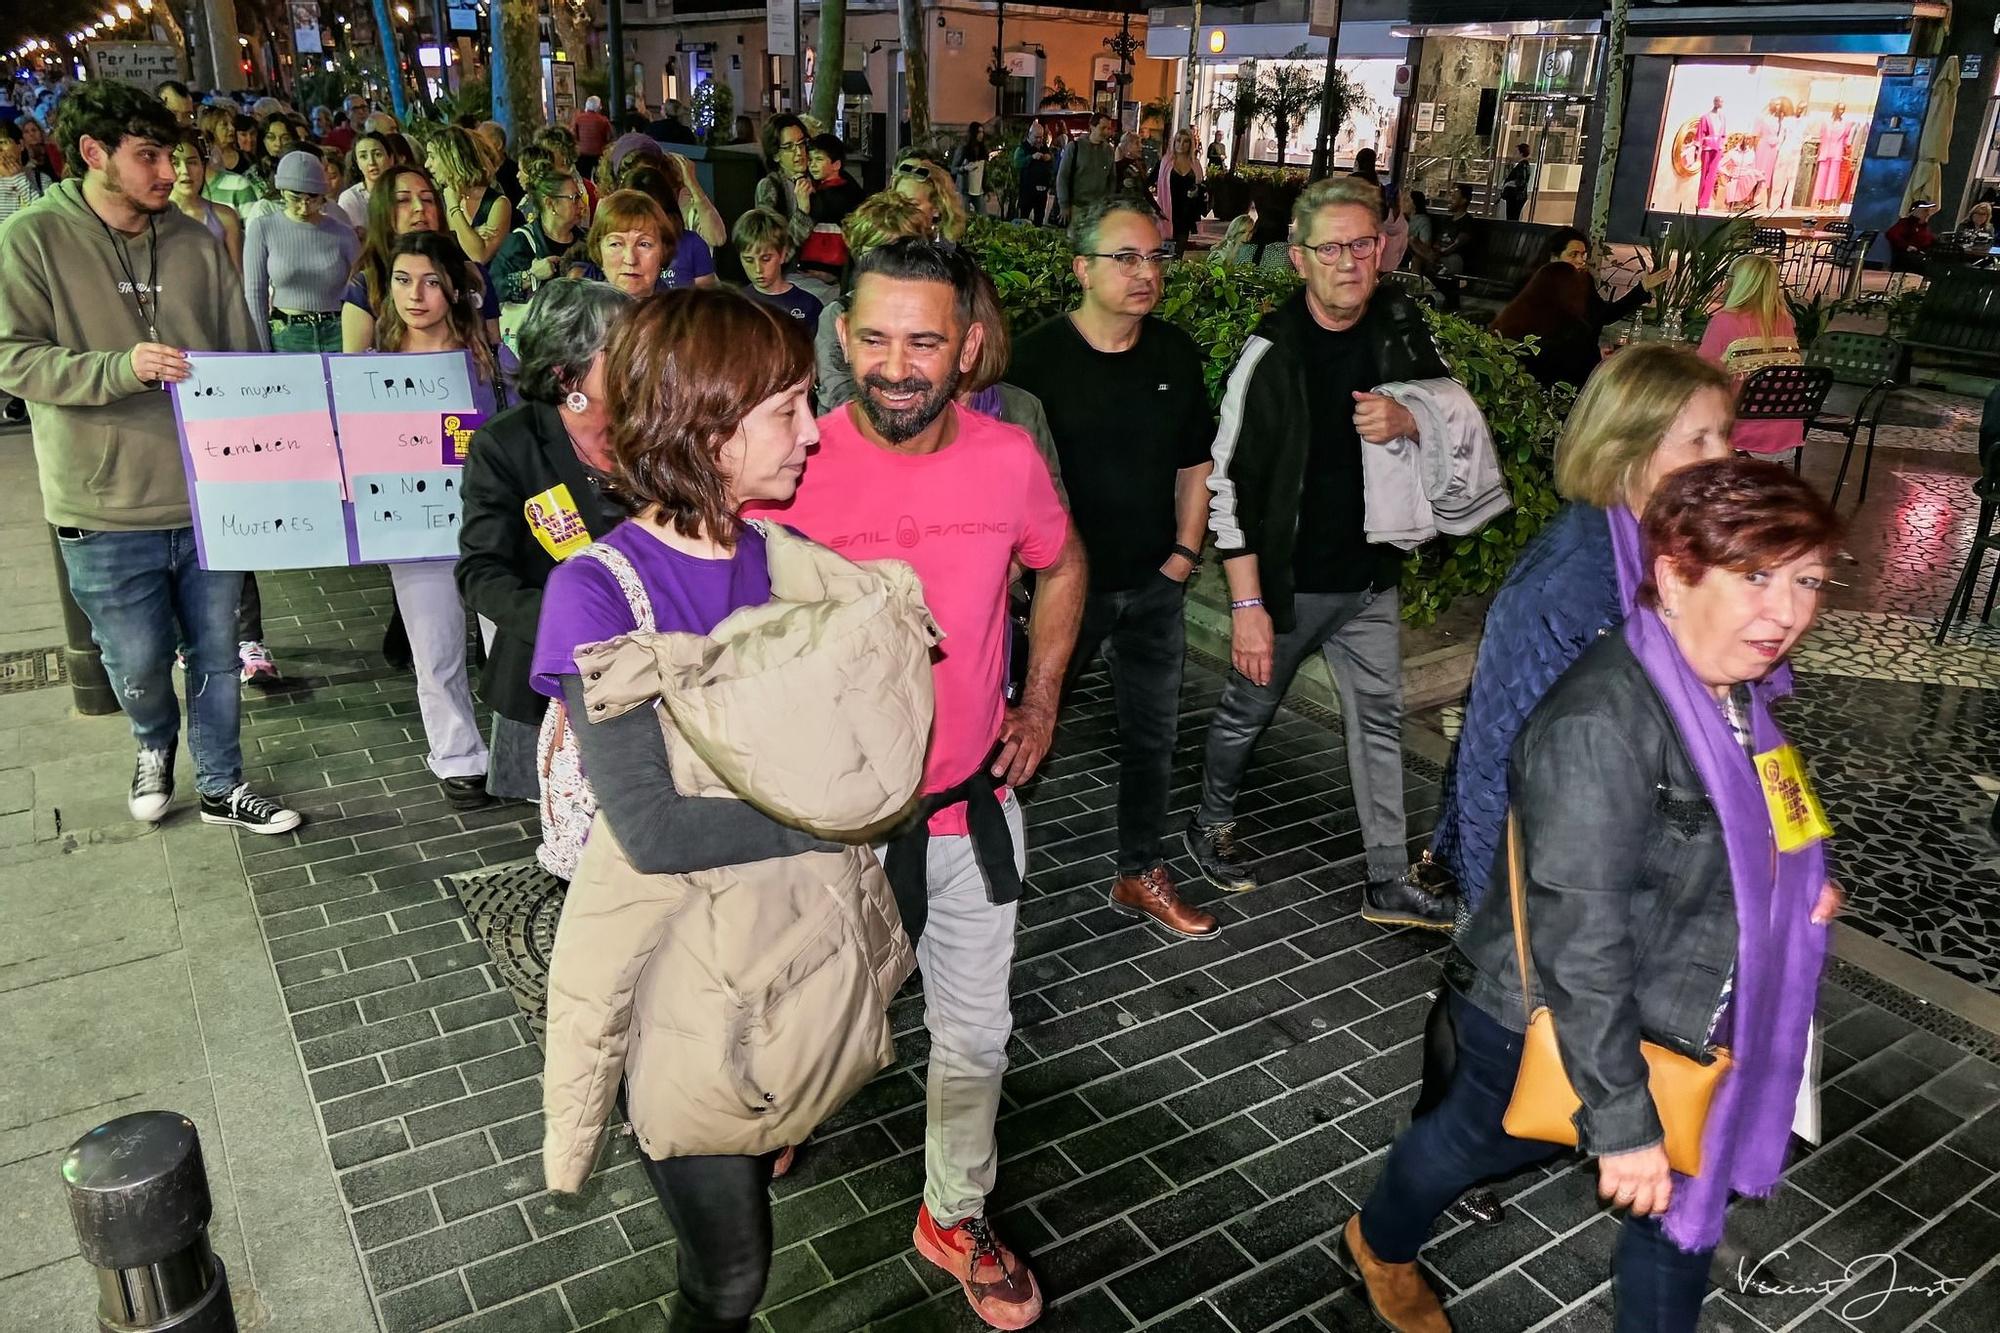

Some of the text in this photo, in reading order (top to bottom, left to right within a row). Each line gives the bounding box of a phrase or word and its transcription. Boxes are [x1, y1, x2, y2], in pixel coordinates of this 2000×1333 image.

[97, 51, 125, 65] Per
[1547, 58, 1560, 70] 30
[126, 69, 142, 78] no
[363, 371, 450, 400] TRANS
[398, 433, 432, 447] son
[370, 477, 454, 495] DI NO A
[374, 510, 402, 522] LAS
[222, 514, 314, 536] MUJERES
[830, 522, 1008, 549] SAIL RACING
